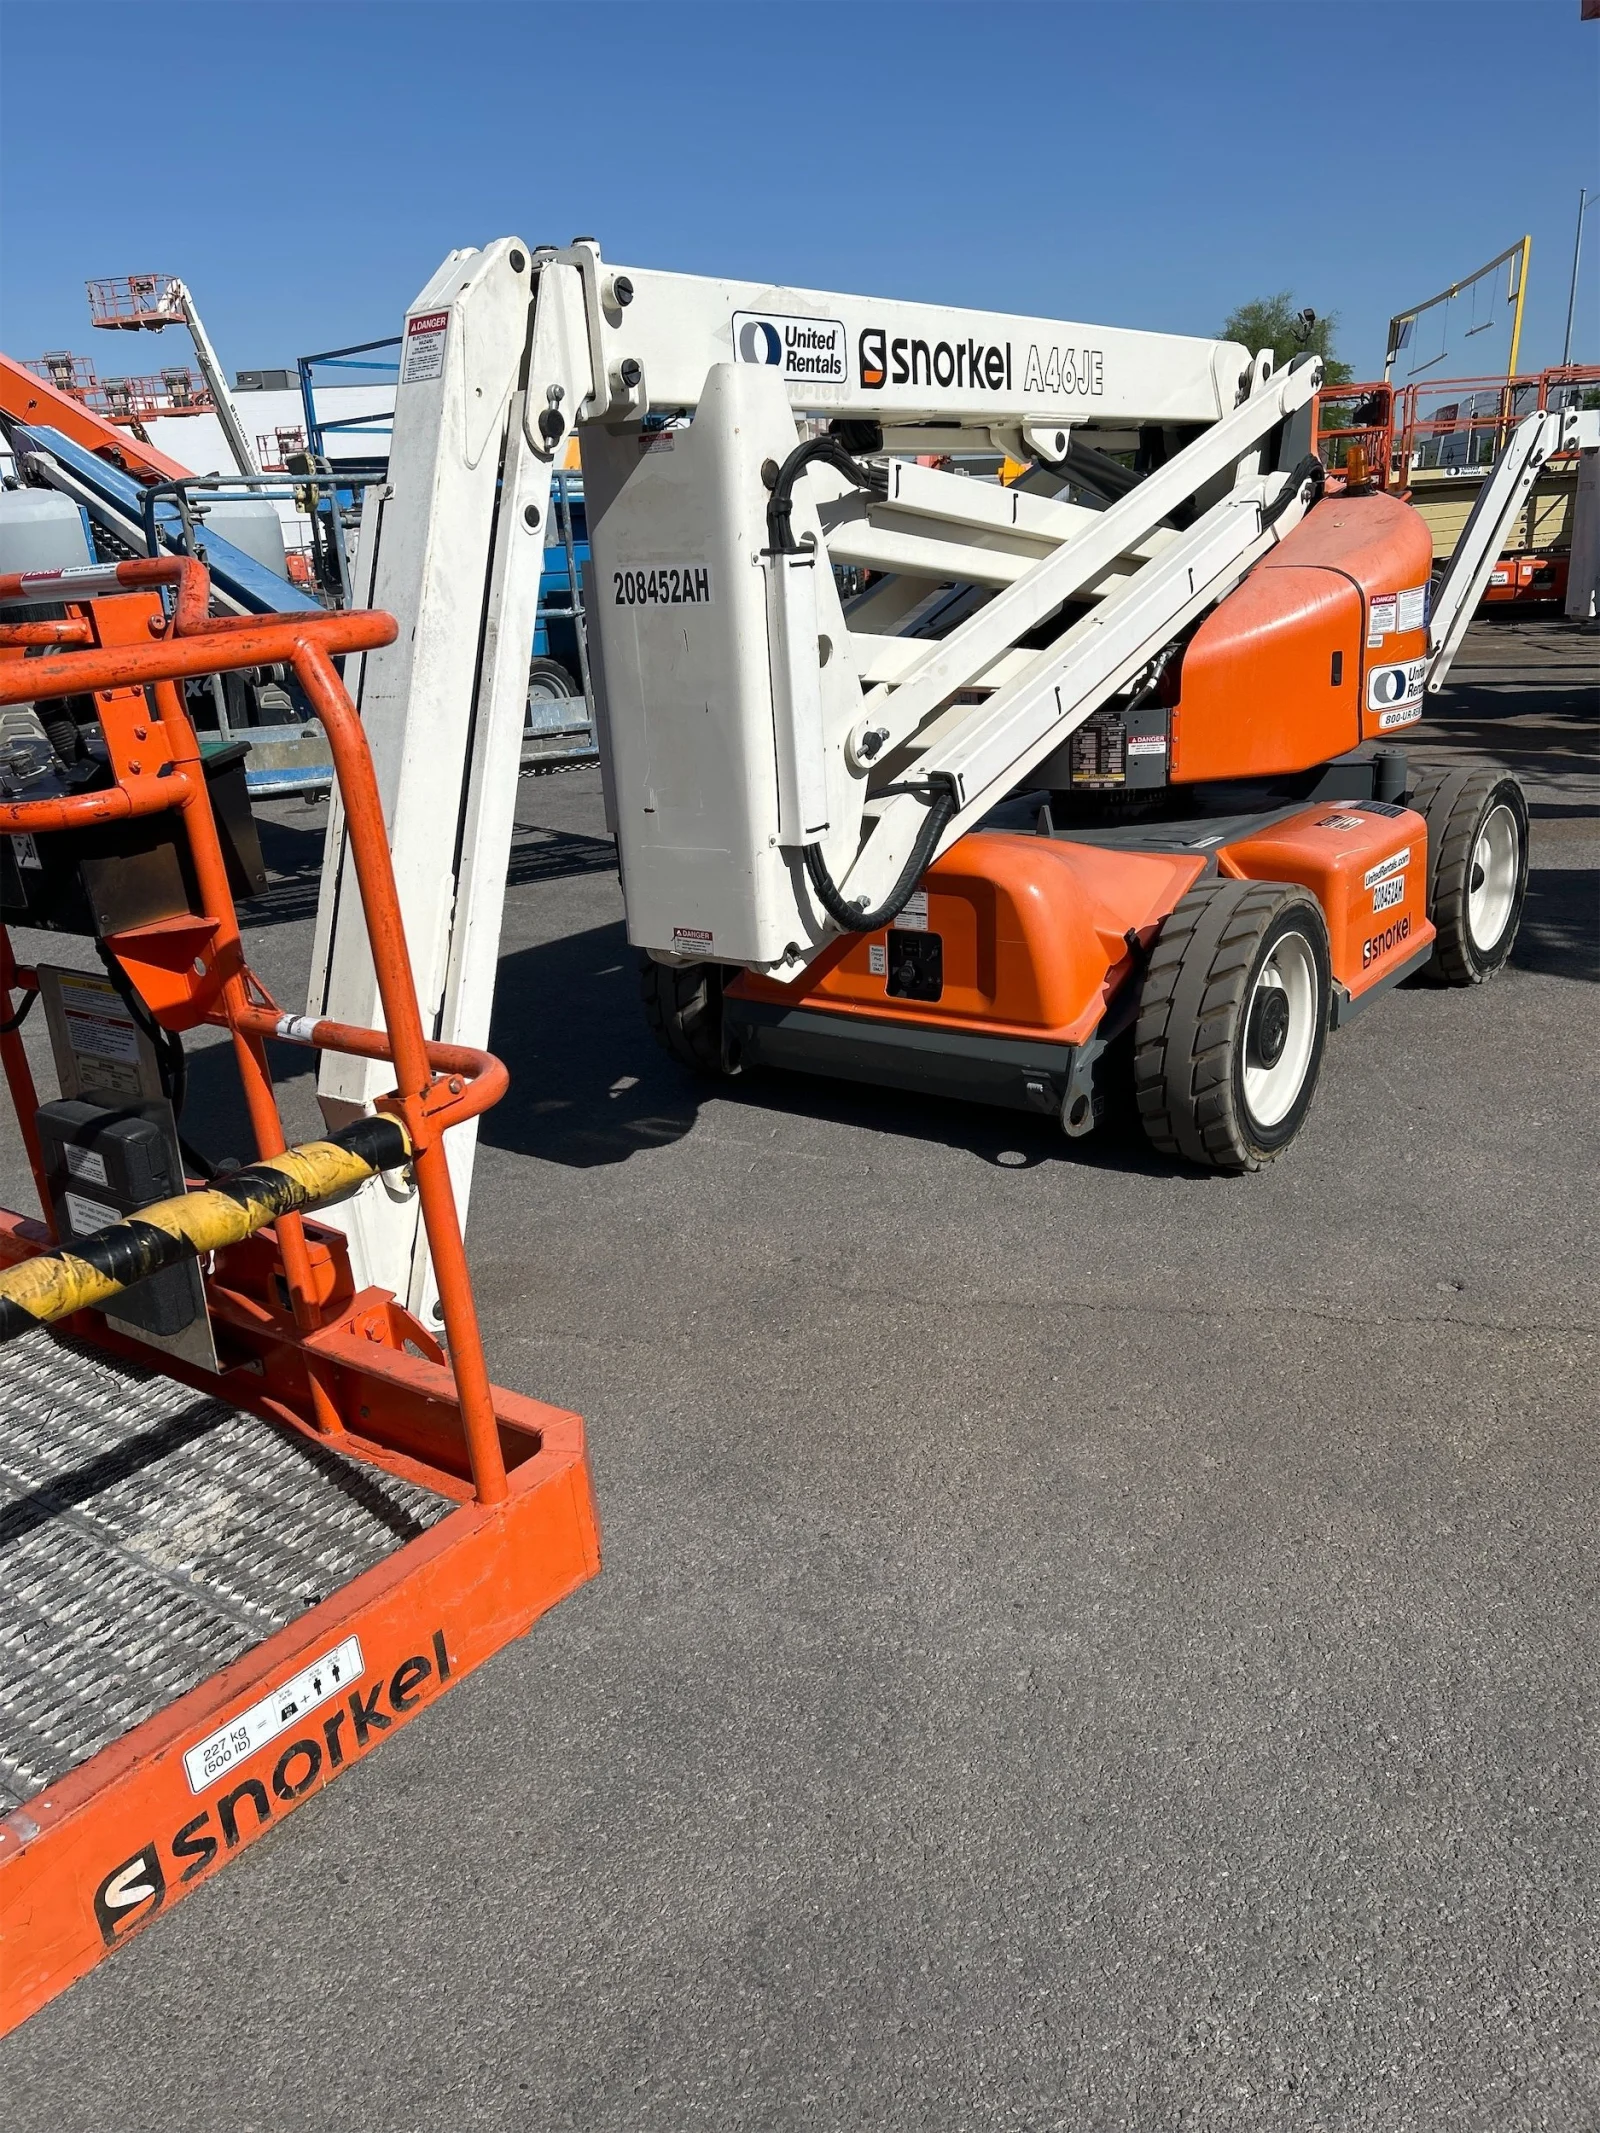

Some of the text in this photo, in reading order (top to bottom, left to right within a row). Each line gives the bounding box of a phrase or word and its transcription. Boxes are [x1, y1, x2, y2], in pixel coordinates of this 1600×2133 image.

[417, 317, 446, 330] DANGER
[785, 326, 836, 351] United
[786, 350, 842, 375] Rentals
[891, 337, 1104, 396] snorkel A46JE
[613, 568, 709, 605] 208452AH
[1375, 595, 1396, 604] DANGER
[1365, 853, 1409, 886] UnitedRentals.com
[1374, 877, 1404, 911] 208452AH
[682, 930, 710, 940] DANGER
[1371, 912, 1412, 960] snorkel
[172, 1629, 451, 1882] snorkel
[203, 1726, 247, 1762] 227 kg
[204, 1736, 251, 1778] (500 lb)
